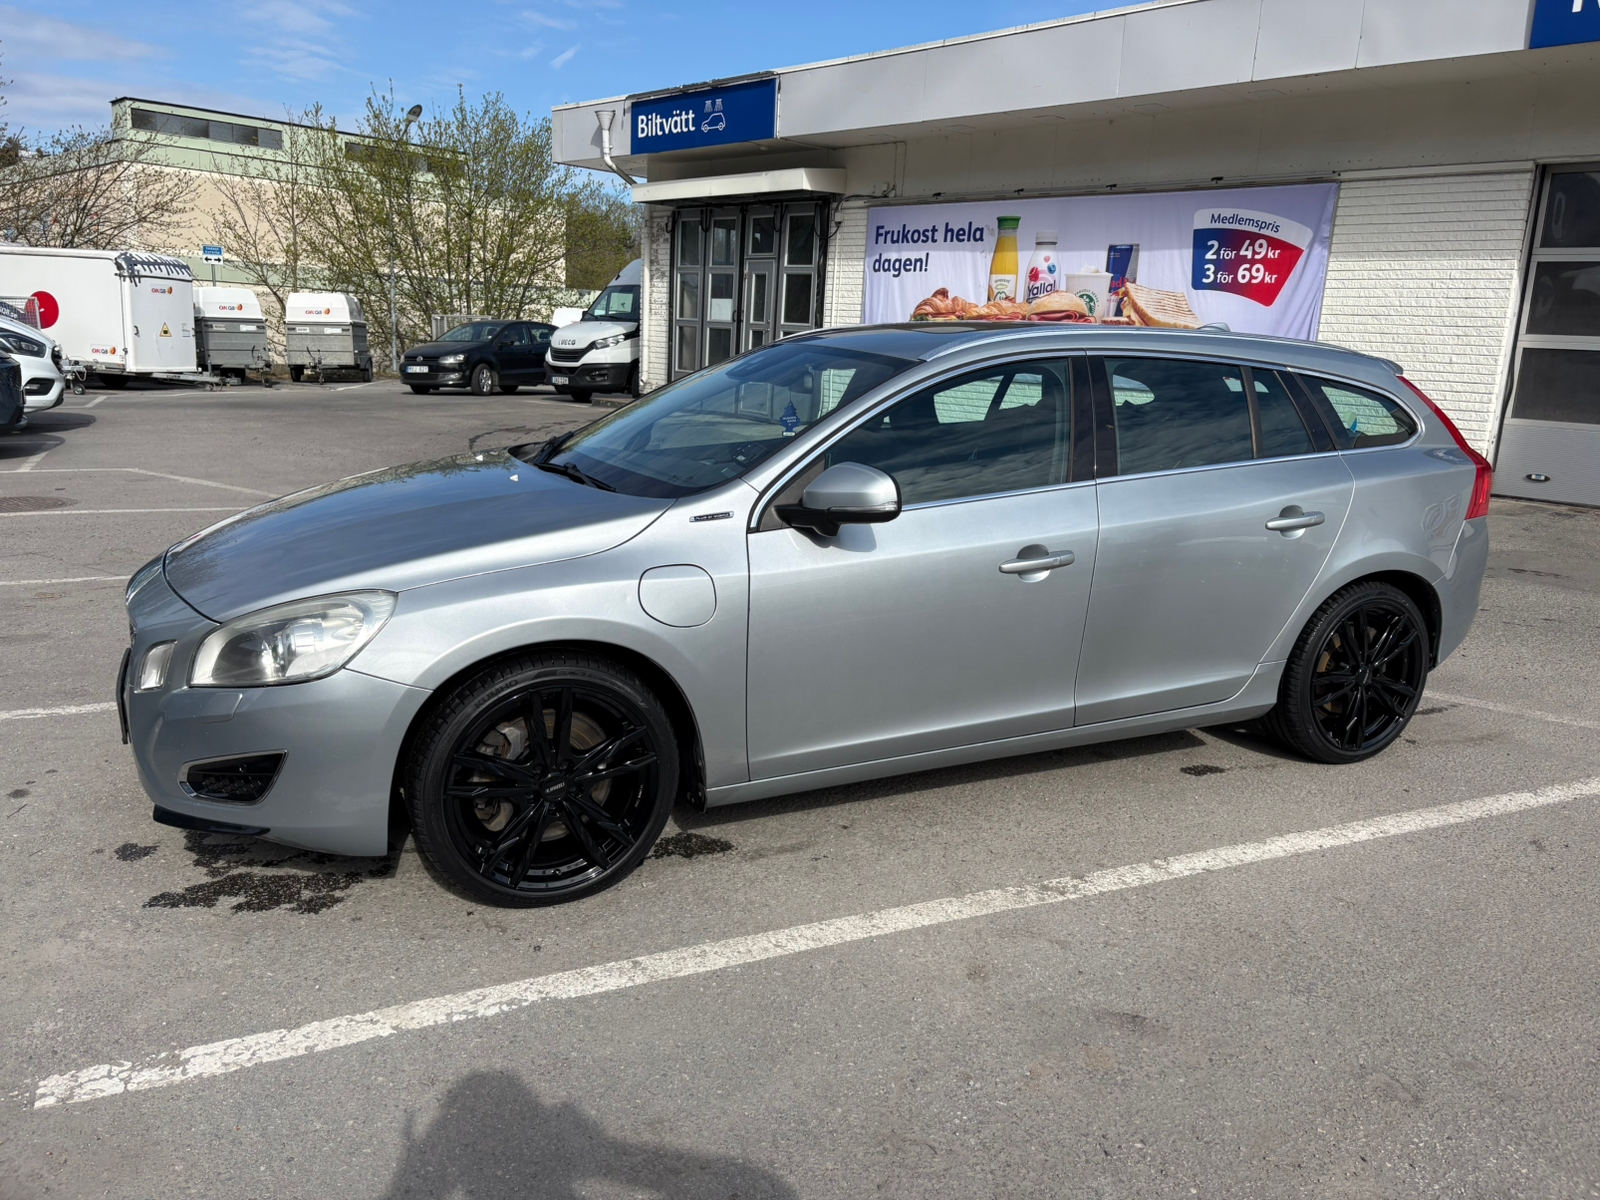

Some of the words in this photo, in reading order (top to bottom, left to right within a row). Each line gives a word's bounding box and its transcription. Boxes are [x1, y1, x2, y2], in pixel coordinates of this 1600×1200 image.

[637, 109, 696, 138] Biltvätt
[875, 223, 938, 244] Frukost
[943, 221, 984, 243] hela
[1210, 213, 1280, 233] Medlemspris
[1205, 240, 1219, 259] 2
[1220, 248, 1237, 259] för
[872, 252, 929, 278] dagen!
[1202, 264, 1215, 283] 3
[1217, 272, 1234, 283] för
[1027, 280, 1056, 298] Yalla!
[558, 338, 576, 346] IVECO
[474, 679, 519, 708] KUMHO
